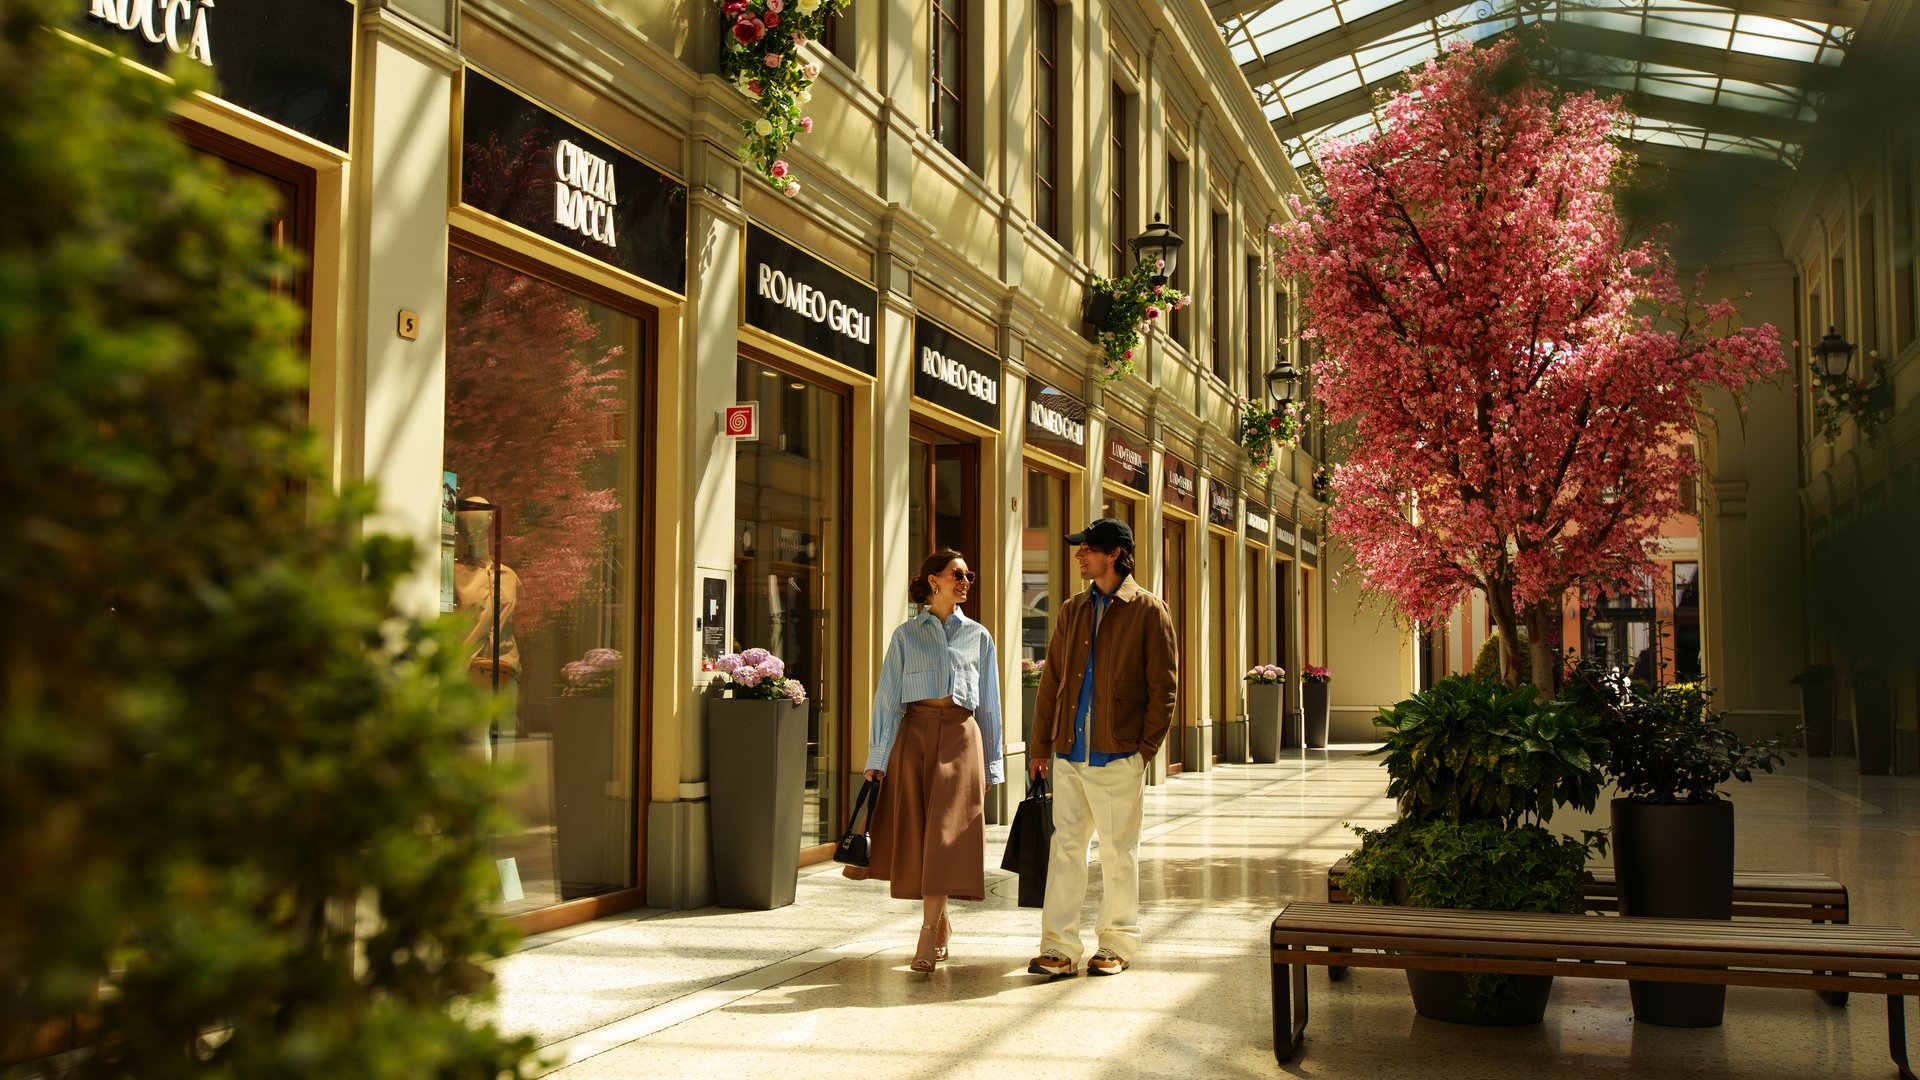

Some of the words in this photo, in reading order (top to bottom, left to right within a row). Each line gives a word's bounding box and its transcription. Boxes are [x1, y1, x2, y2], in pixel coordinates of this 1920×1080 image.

[555, 139, 618, 206] CINZIA
[554, 181, 617, 247] ROCCA
[406, 318, 413, 332] 5
[758, 262, 827, 323] ROMEO
[827, 299, 870, 345] GIGLI
[922, 346, 968, 391] ROMEO
[967, 369, 997, 405] GIGLI
[1031, 400, 1063, 436] ROMEO
[1062, 417, 1084, 446] GIGLI
